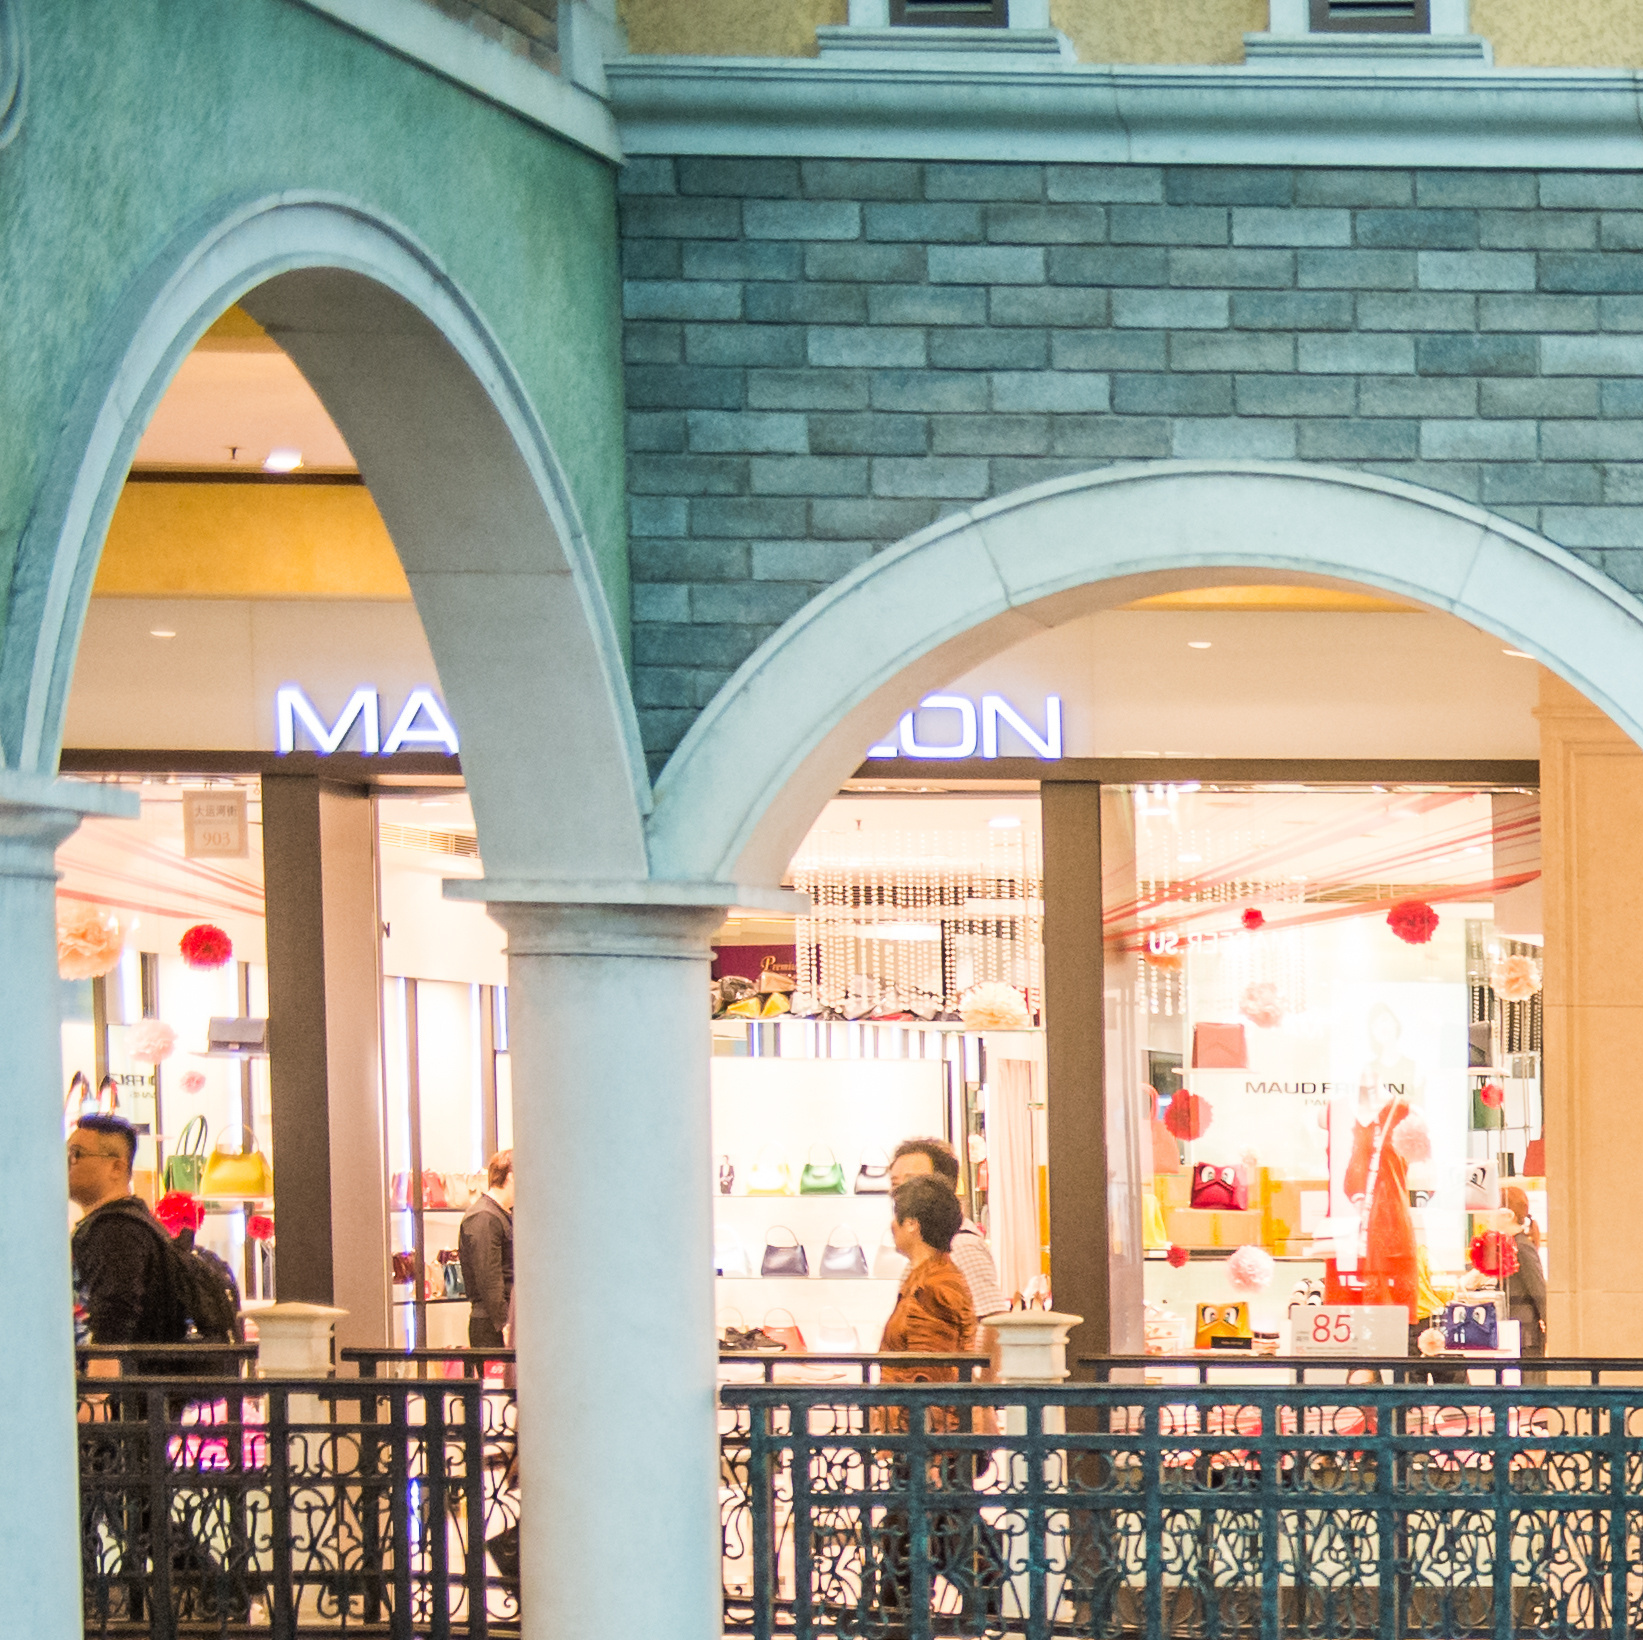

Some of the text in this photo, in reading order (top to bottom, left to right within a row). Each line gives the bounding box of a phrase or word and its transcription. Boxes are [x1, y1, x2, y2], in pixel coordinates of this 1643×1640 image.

[276, 688, 460, 754] MA
[203, 832, 231, 847] 903
[1245, 1082, 1316, 1094] MAUD
[1313, 1313, 1351, 1342] 85
